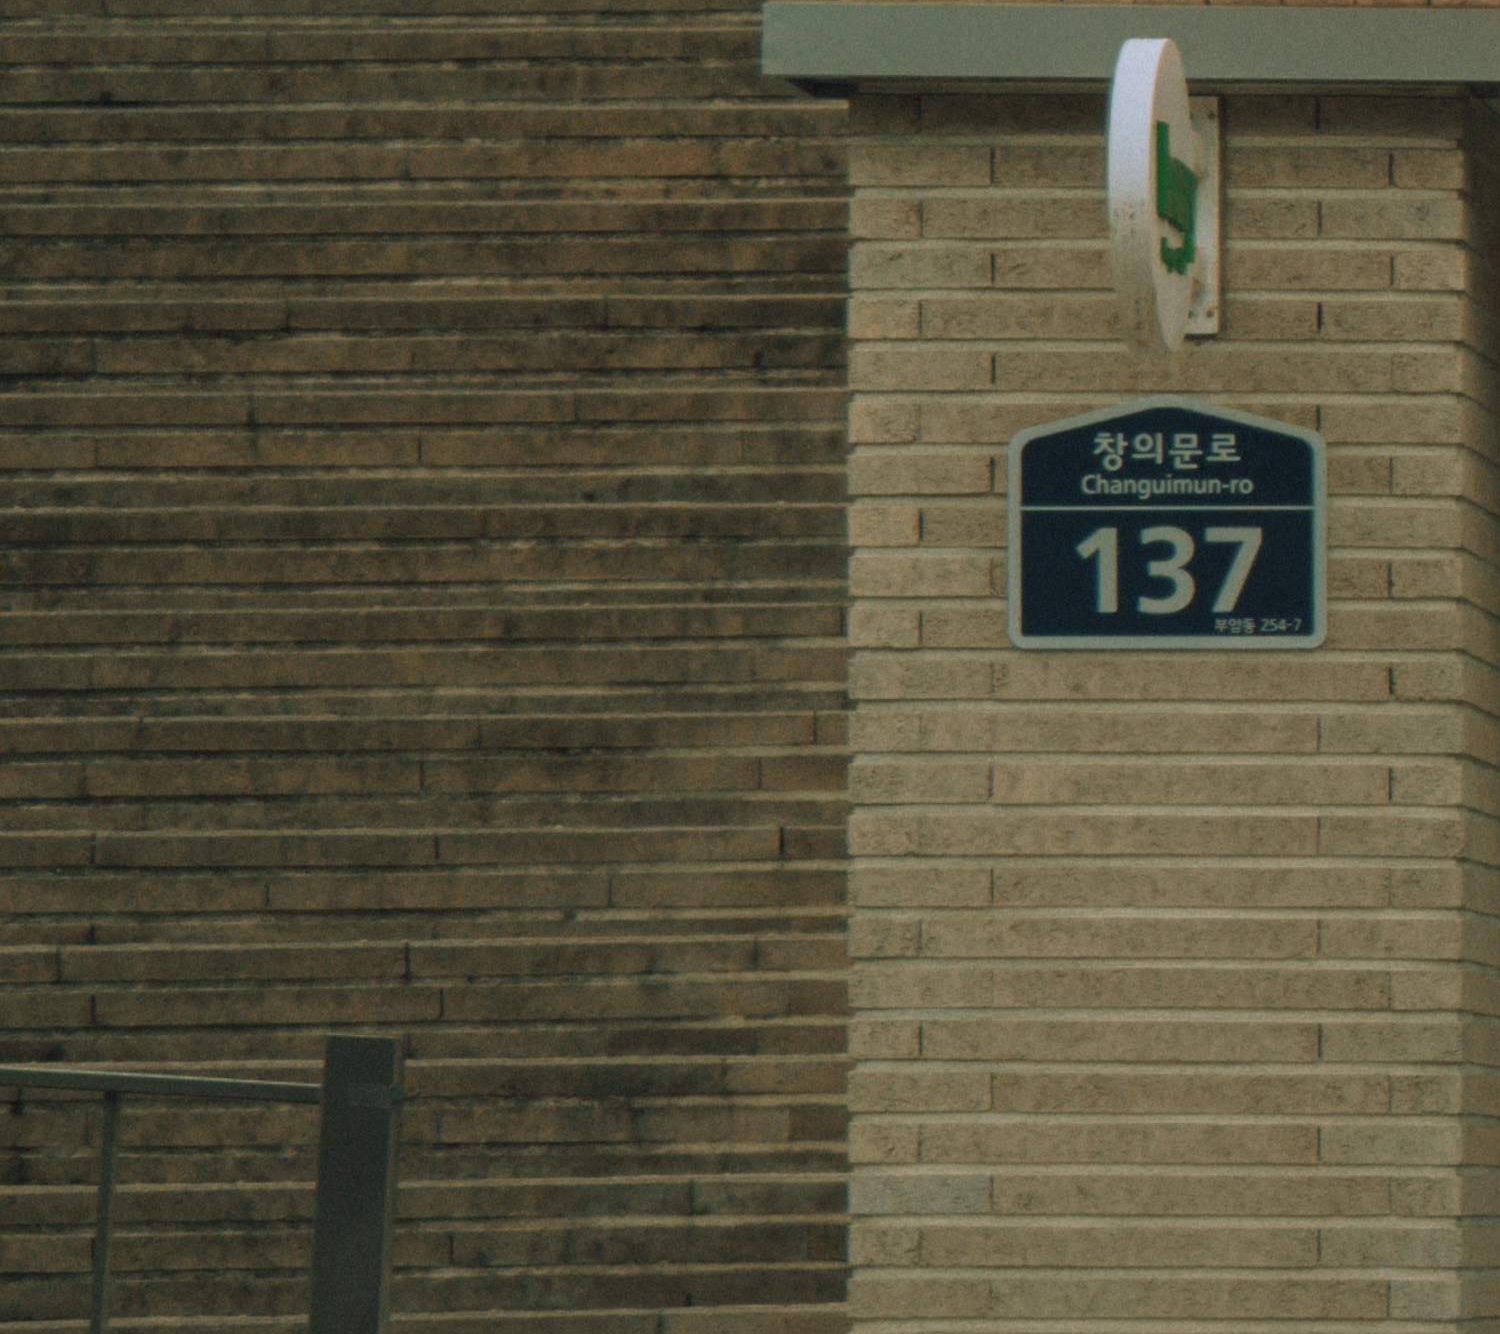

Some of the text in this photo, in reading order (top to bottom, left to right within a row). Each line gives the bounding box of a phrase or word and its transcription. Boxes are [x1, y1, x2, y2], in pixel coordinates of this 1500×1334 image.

[1093, 432, 1241, 471] 창의문로
[1081, 474, 1254, 499] Changuimun-ro
[1075, 526, 1263, 614] 137
[1214, 617, 1302, 634] 부암동 254-7
